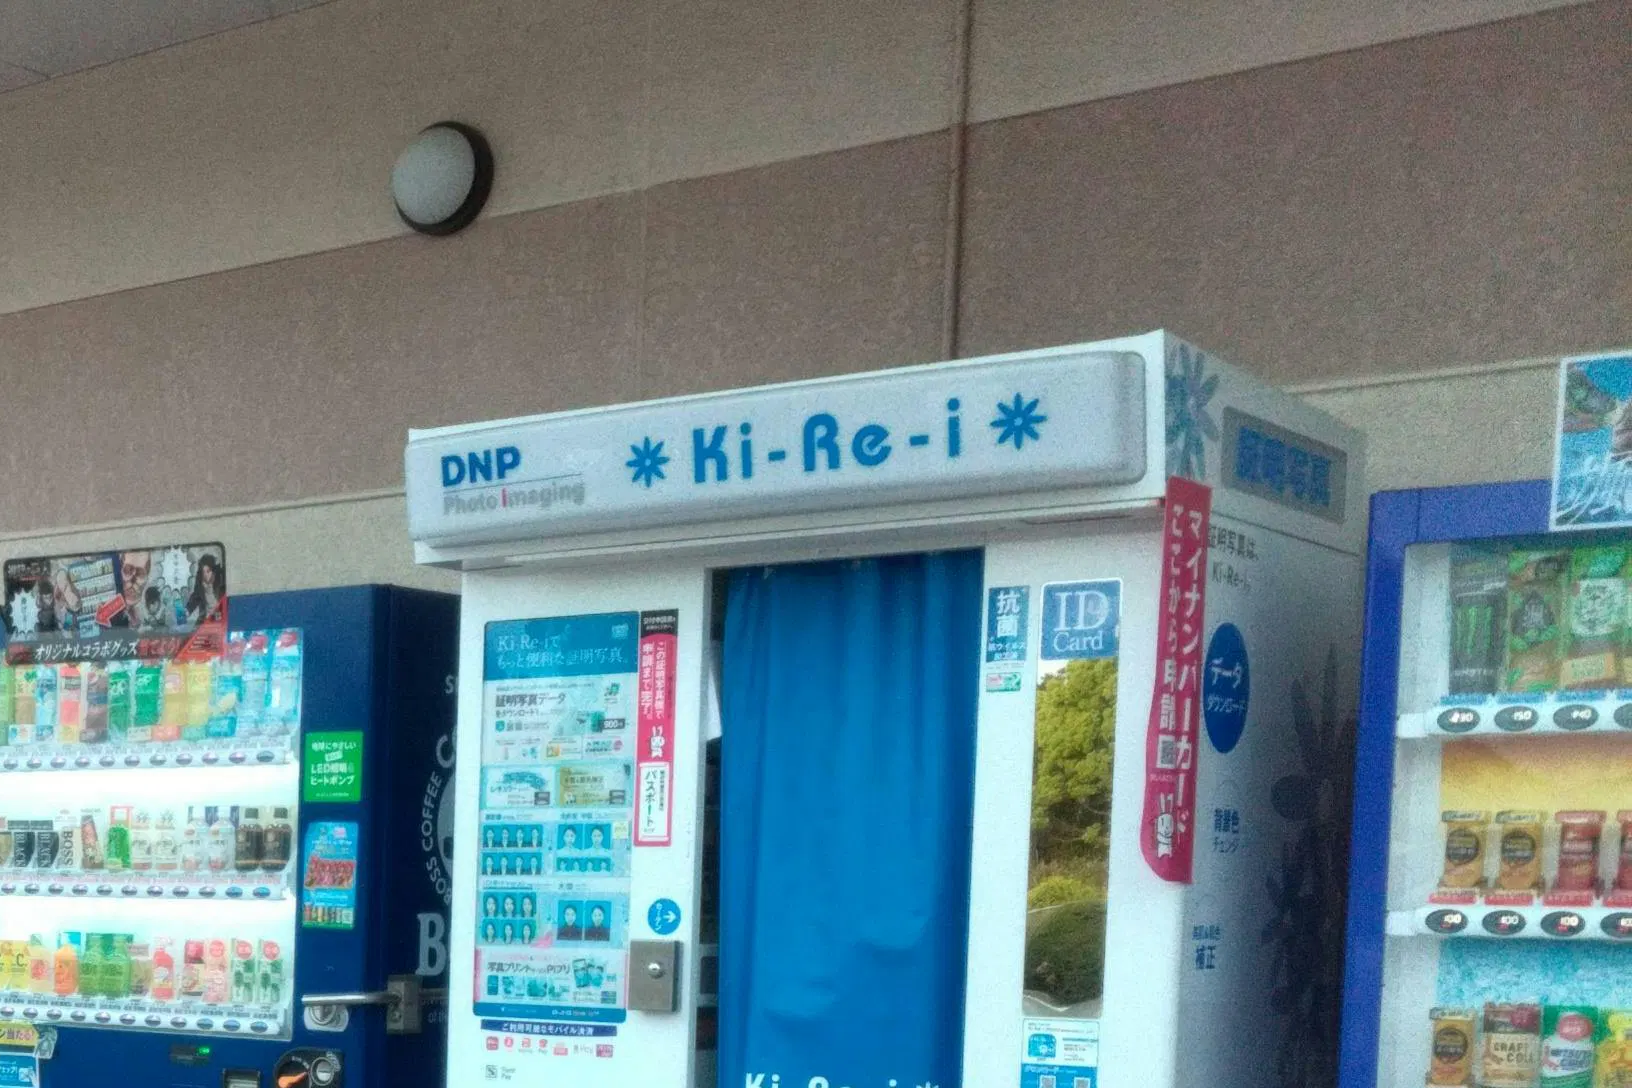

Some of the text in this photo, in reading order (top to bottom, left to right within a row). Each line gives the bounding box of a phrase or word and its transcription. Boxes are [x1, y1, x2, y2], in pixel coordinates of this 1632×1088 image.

[693, 397, 960, 484] Ki-Re-i
[441, 446, 521, 487] DNP
[443, 491, 498, 515] Photo
[1054, 590, 1110, 632] ID
[1053, 630, 1104, 651] Card
[421, 770, 442, 851] COFFEE
